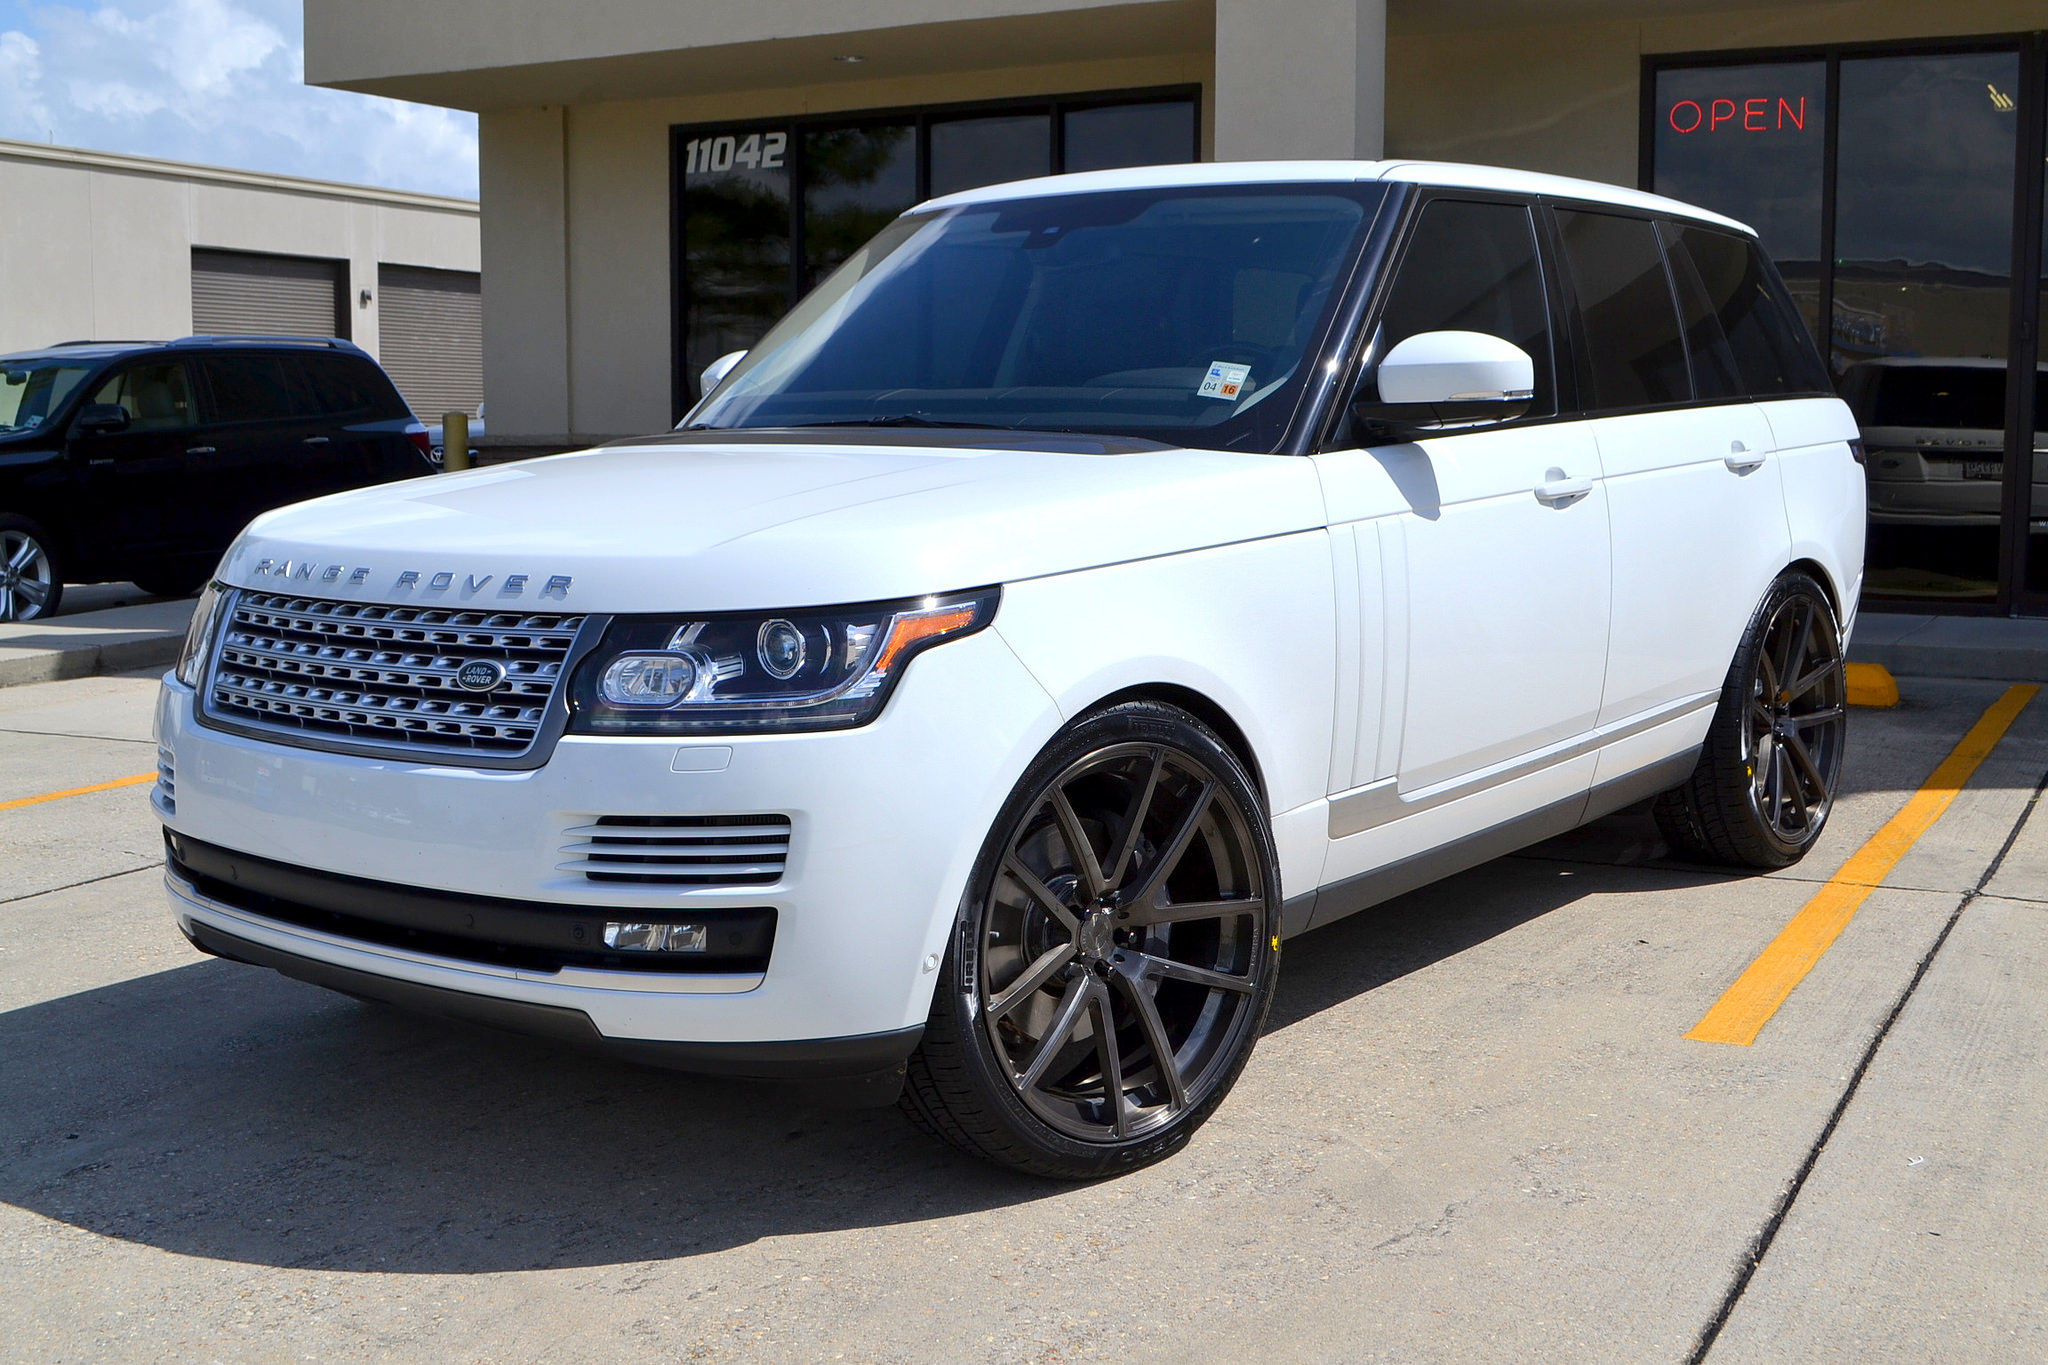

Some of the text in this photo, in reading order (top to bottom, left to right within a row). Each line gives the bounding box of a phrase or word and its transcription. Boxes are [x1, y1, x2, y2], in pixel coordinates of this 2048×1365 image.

[1669, 96, 1805, 133] OPEN
[686, 132, 788, 174] 11042
[1203, 382, 1236, 395] 04 16
[254, 558, 575, 595] RANGE ROVER
